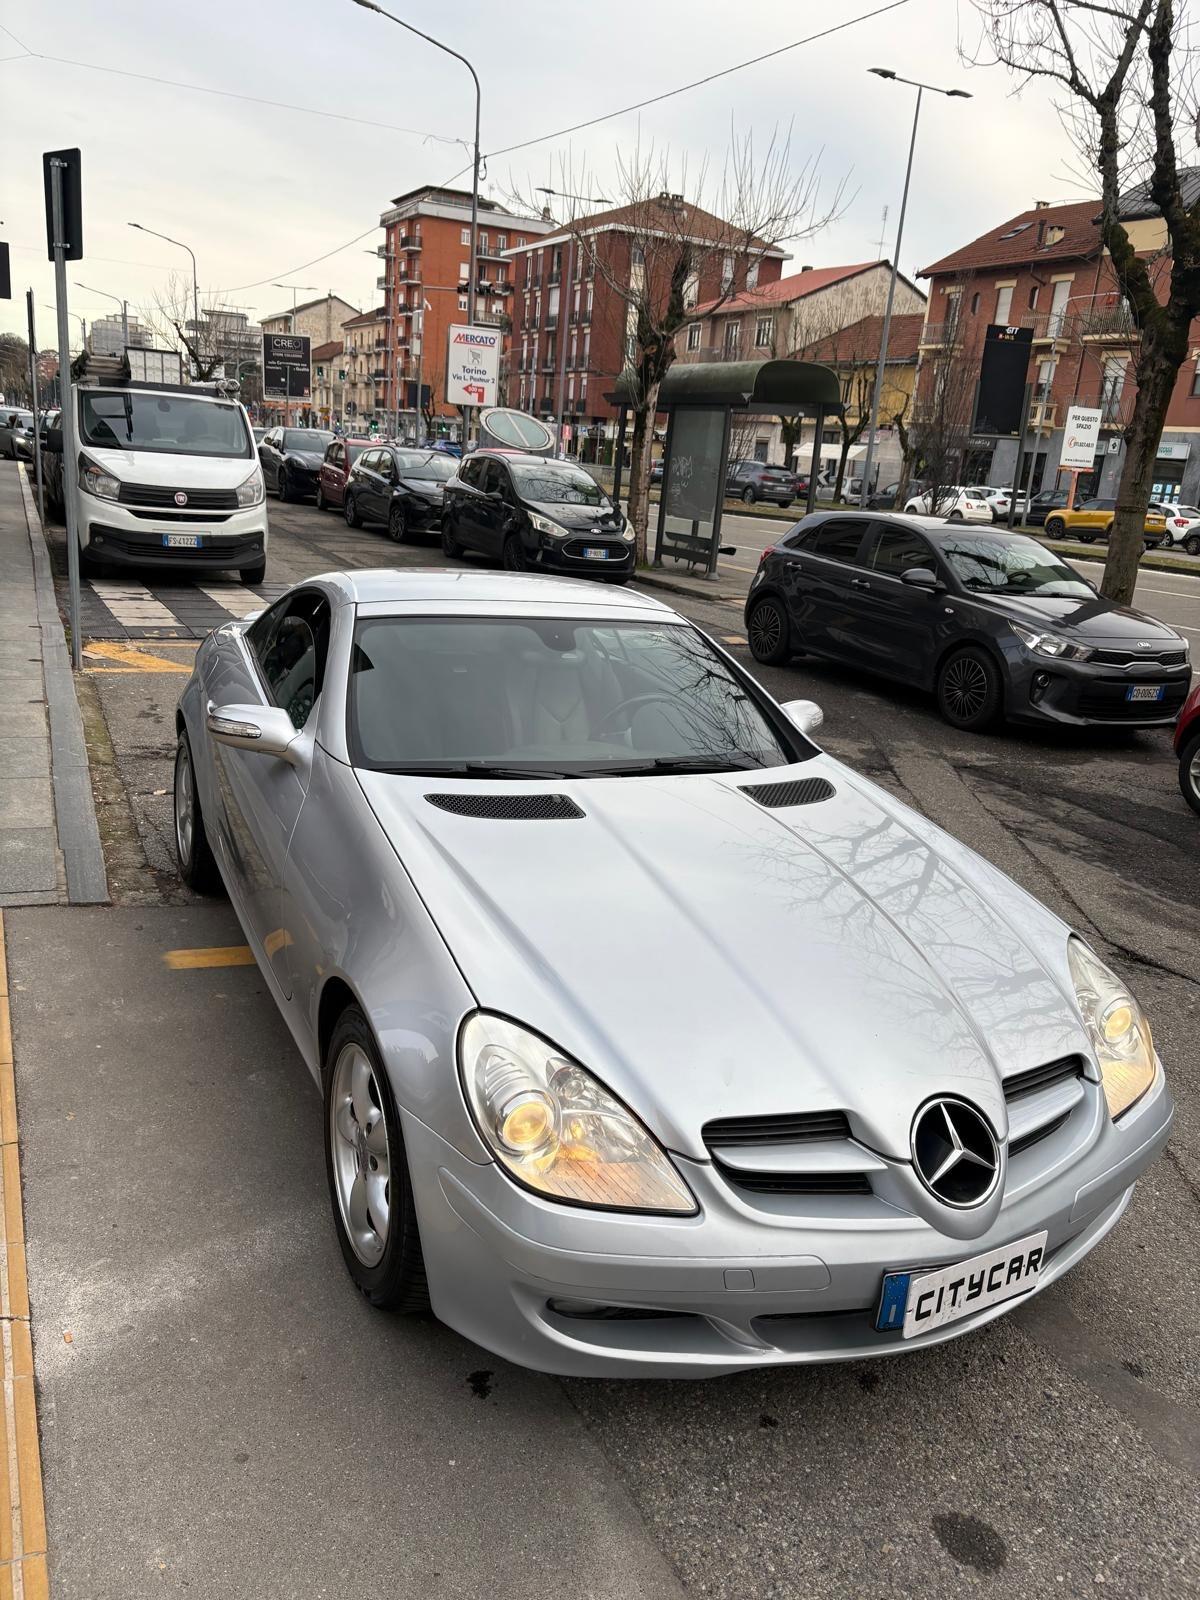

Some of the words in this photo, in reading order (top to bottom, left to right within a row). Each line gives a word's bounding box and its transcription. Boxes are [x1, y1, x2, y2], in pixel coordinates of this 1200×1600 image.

[273, 338, 300, 348] CREO
[462, 365, 487, 376] Torino
[915, 1247, 1043, 1321] CITYCAR
